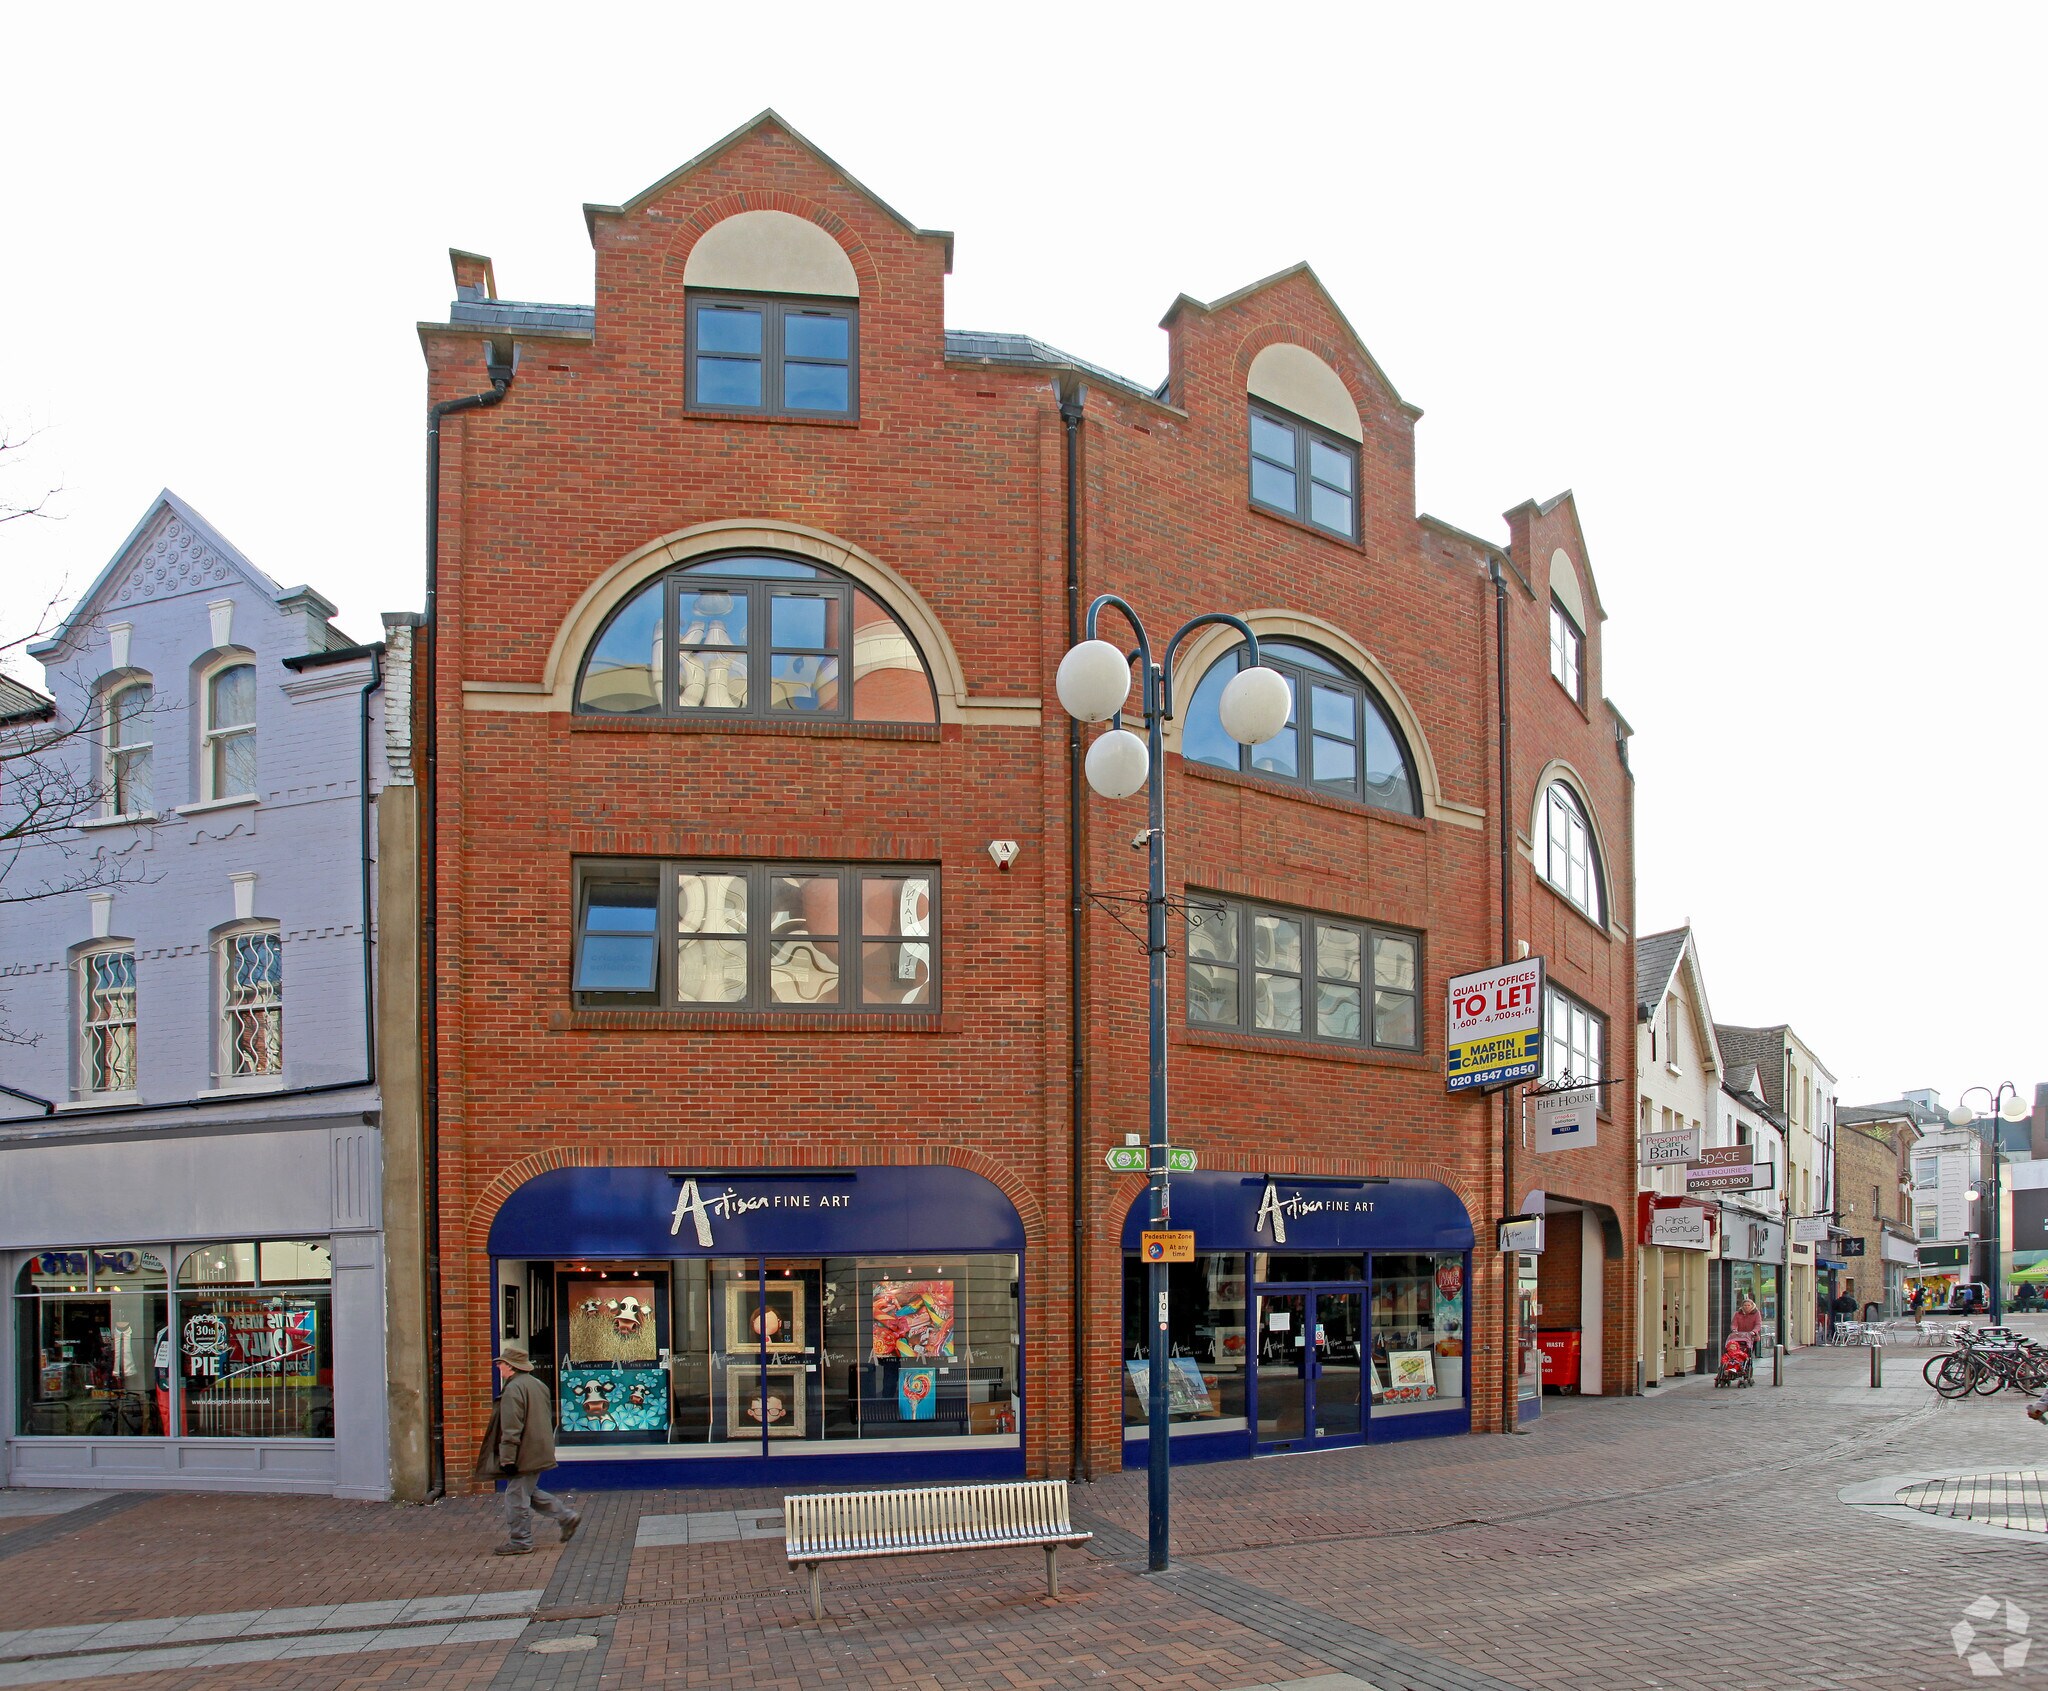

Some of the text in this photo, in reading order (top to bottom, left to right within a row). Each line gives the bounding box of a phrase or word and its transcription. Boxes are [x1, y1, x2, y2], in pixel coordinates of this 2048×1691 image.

[1453, 971, 1536, 997] QUALITY OFFICES
[1453, 982, 1536, 1019] TO LET
[1453, 1018, 1477, 1029] 1,600
[1470, 1038, 1515, 1056] MARTIN
[1462, 1048, 1523, 1067] CAMPBELL
[1451, 1064, 1535, 1087] 020 8547 0850
[1537, 1093, 1594, 1110] FIFE HOUSE
[1646, 1132, 1691, 1145] Personnel
[1650, 1144, 1689, 1159] Bank
[1708, 1167, 1747, 1176] ENQUIRIES
[1690, 1180, 1710, 1188] 0345
[1729, 1177, 1749, 1185] 3900
[670, 1178, 850, 1247] Artisan FINE ART
[1256, 1180, 1374, 1243] Artisan FINE ART
[1655, 1225, 1700, 1234] Avenue
[196, 1325, 216, 1336] 30th
[191, 1357, 220, 1376] PIE
